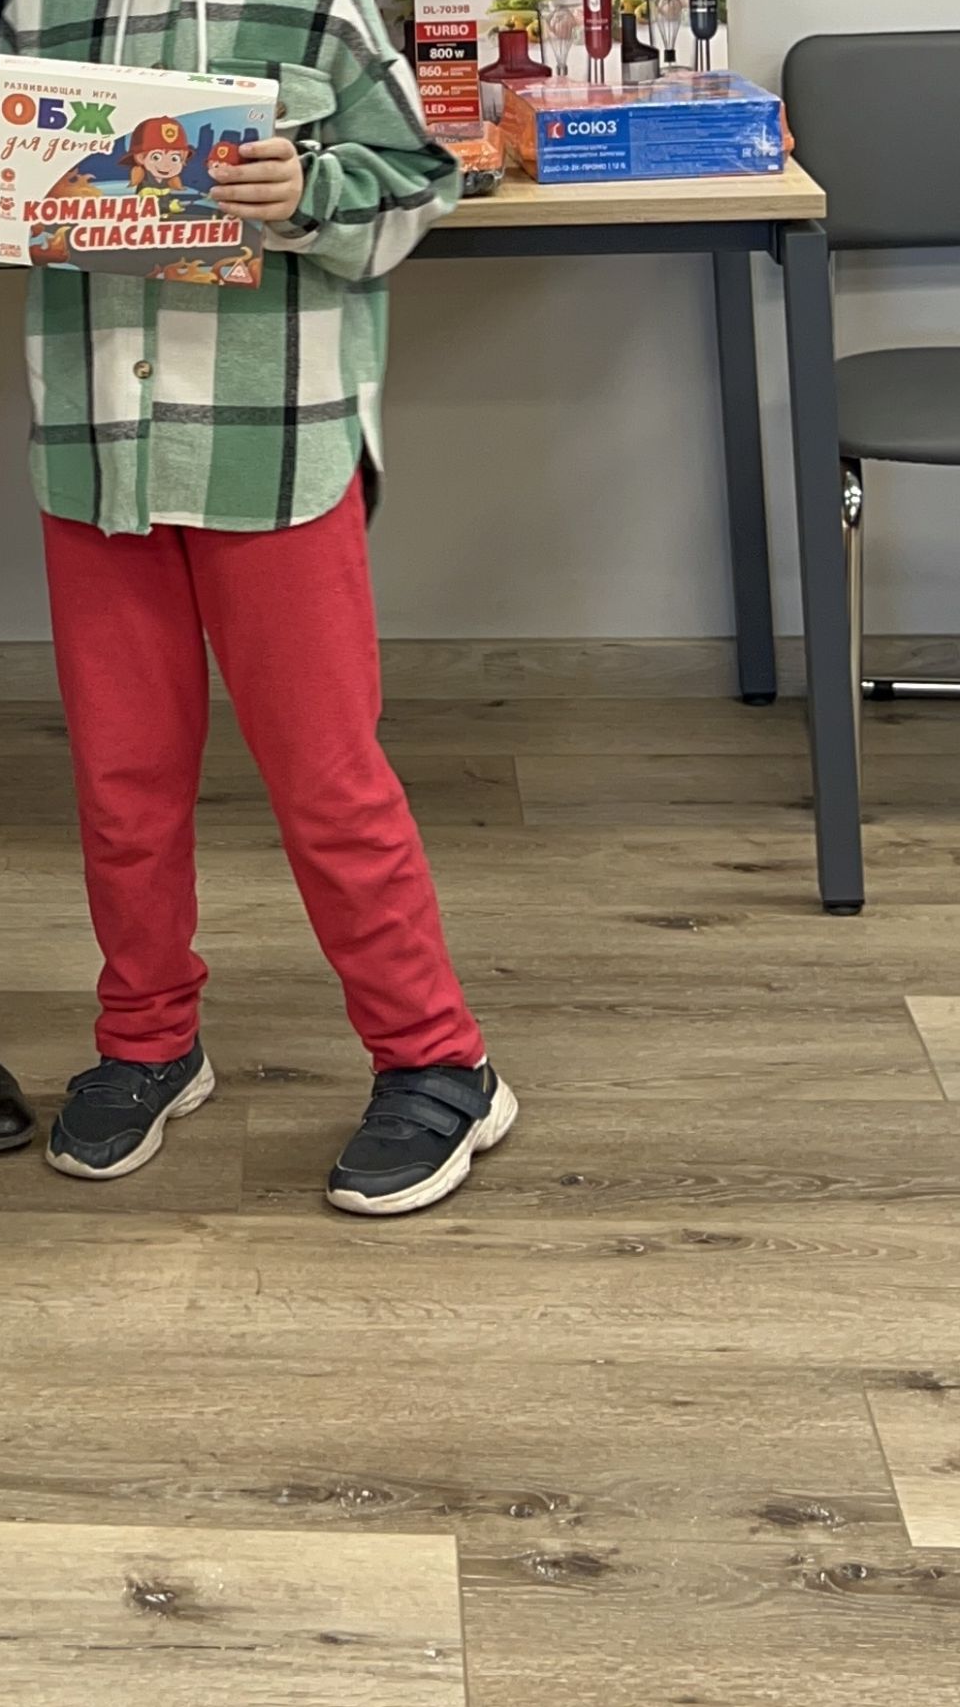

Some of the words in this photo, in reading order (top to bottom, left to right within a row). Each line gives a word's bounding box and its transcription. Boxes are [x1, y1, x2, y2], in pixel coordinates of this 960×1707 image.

[424, 24, 470, 36] TURBO
[429, 47, 453, 59] 800
[419, 65, 442, 77] 860
[3, 81, 82, 97] РАЗВИВАЮЩАЯ
[92, 90, 118, 100] ИГРА
[420, 84, 443, 96] 600
[1, 93, 117, 136] ОБЖ
[425, 103, 447, 114] LED
[567, 119, 618, 136] СОЮЗ
[0, 135, 42, 161] для
[42, 134, 113, 163] детей
[22, 196, 158, 223] КОМАНДА
[73, 215, 241, 248] СПАСАТЕЛЕЙ
